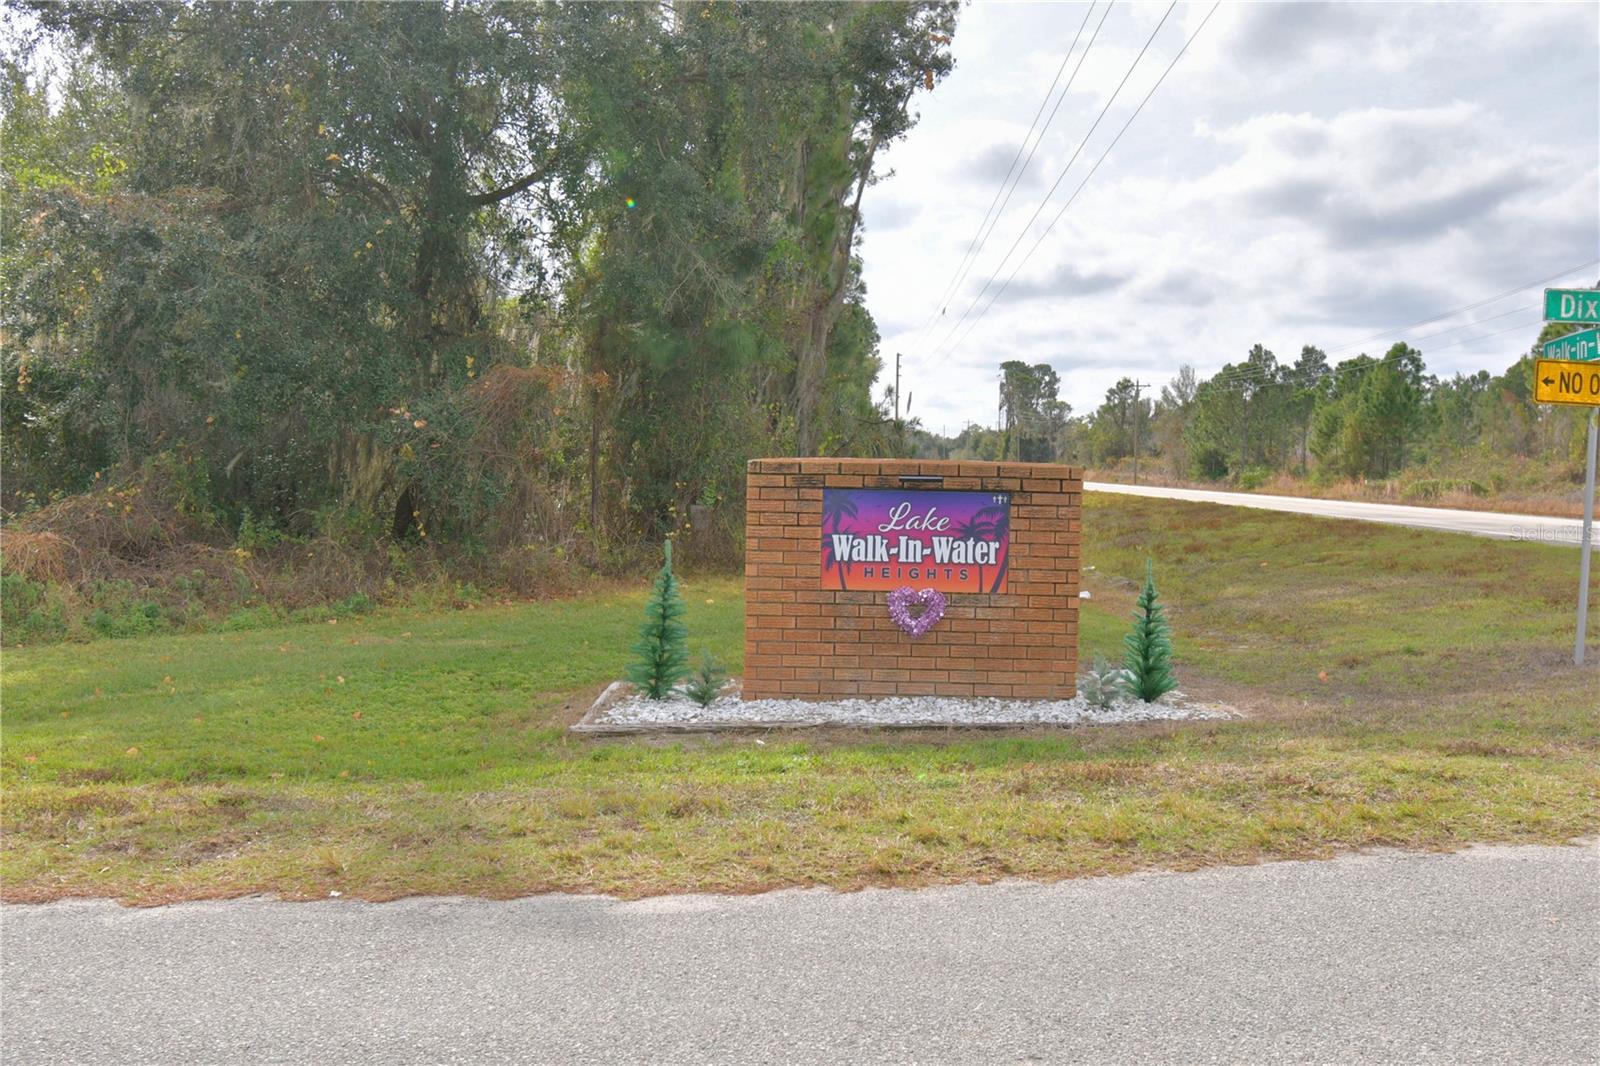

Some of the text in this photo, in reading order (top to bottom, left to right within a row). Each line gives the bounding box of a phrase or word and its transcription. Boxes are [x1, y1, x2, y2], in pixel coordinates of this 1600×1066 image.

[1559, 371, 1583, 394] NO
[878, 502, 951, 532] Lake
[832, 534, 1000, 565] Walk-In-Water
[863, 567, 969, 581] HEIGHTS
